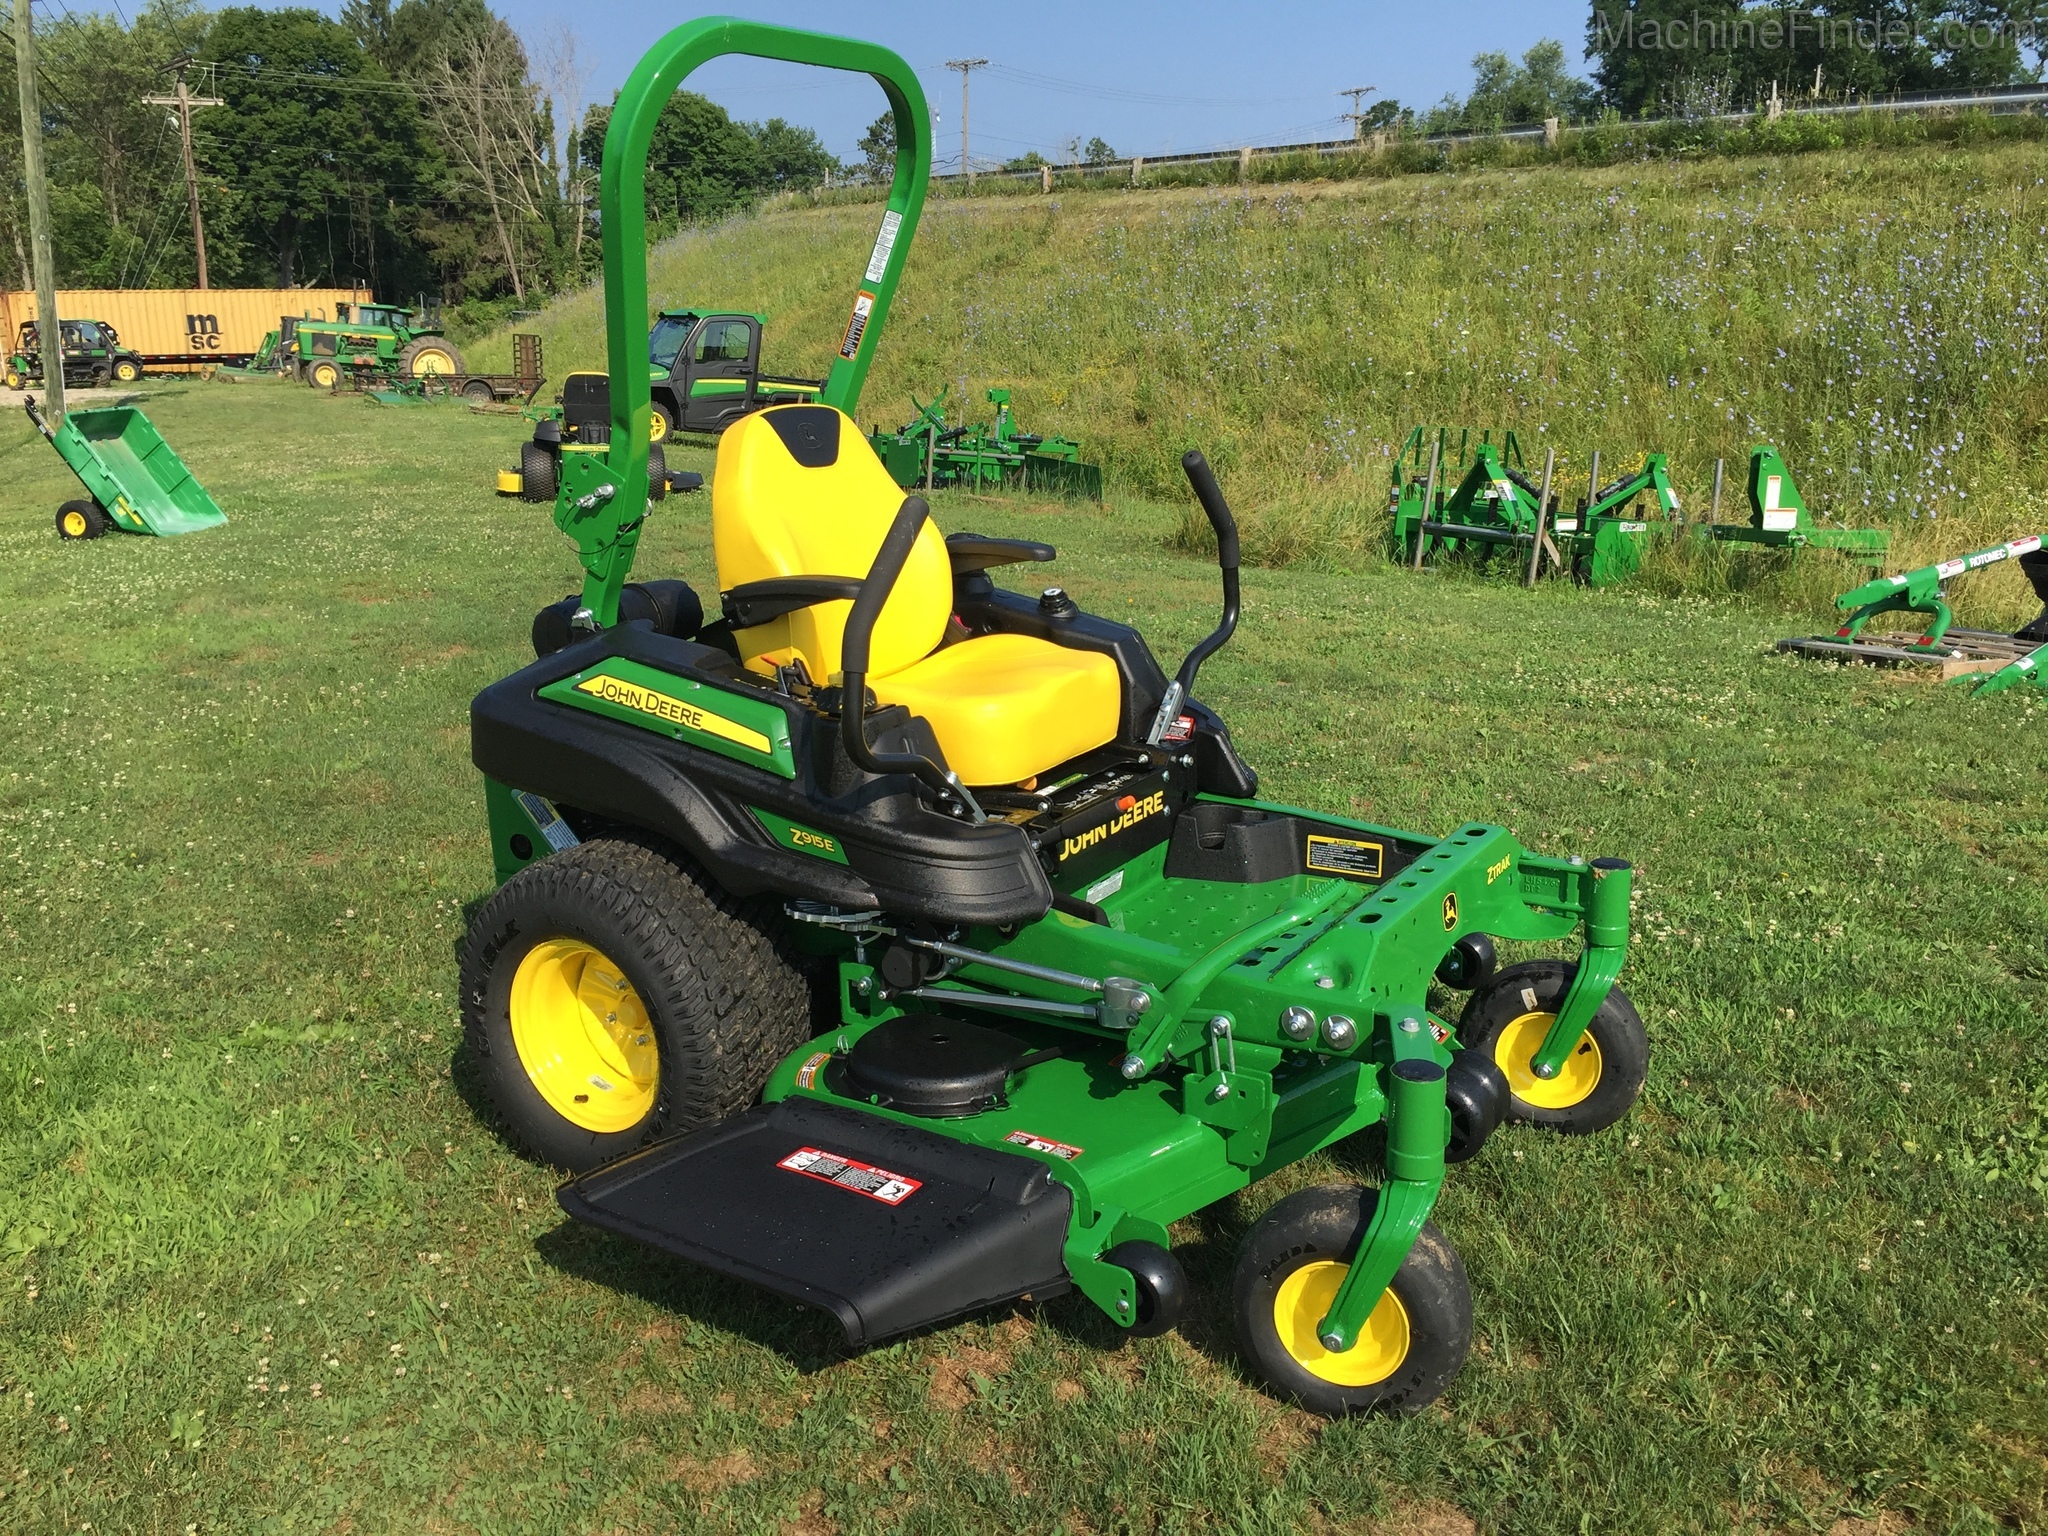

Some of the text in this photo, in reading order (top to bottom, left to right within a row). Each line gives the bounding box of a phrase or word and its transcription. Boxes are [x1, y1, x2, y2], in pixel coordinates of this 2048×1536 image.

[1969, 548, 2007, 568] ROTOMEC
[595, 678, 703, 728] JOHN DEERE
[1060, 823, 1107, 861] JOHN
[1110, 790, 1164, 835] DEERE
[789, 827, 835, 852] Z915E
[1486, 853, 1511, 886] ZTRAK
[820, 1150, 849, 1164] DANGER
[876, 1169, 906, 1182] PELIGRO
